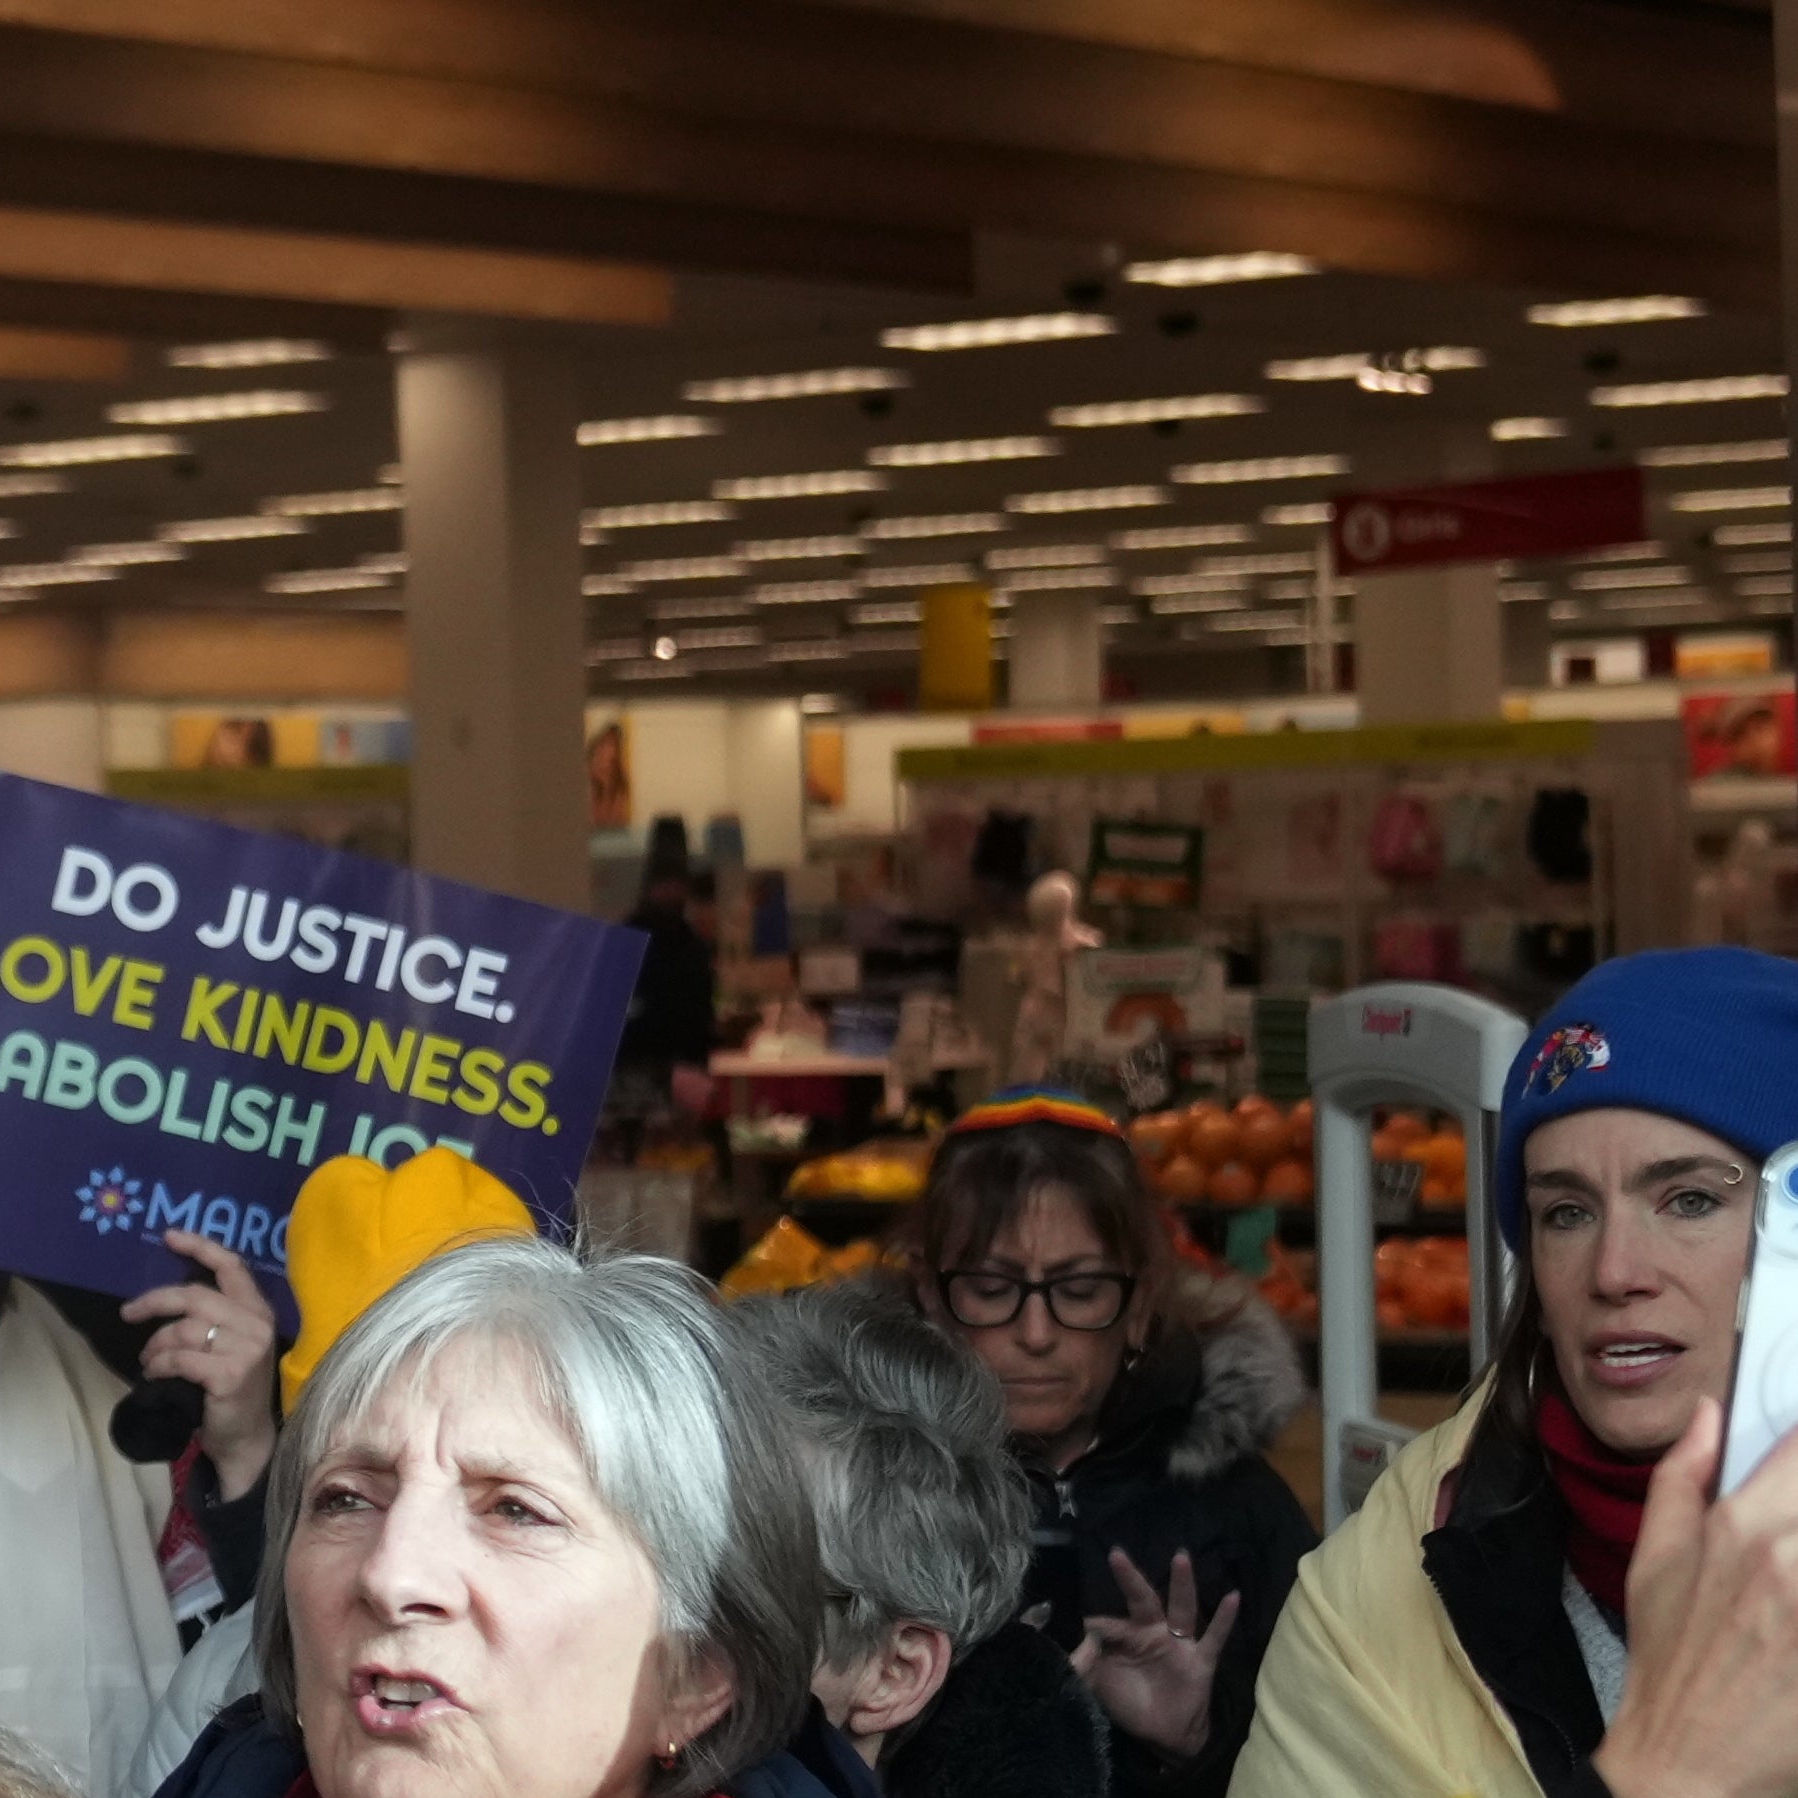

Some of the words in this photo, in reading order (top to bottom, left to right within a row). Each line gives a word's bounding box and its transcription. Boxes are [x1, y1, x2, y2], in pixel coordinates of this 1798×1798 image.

[50, 845, 180, 933] DO
[195, 885, 517, 1024] JUSTICE.
[180, 975, 561, 1136] KINDNESS.
